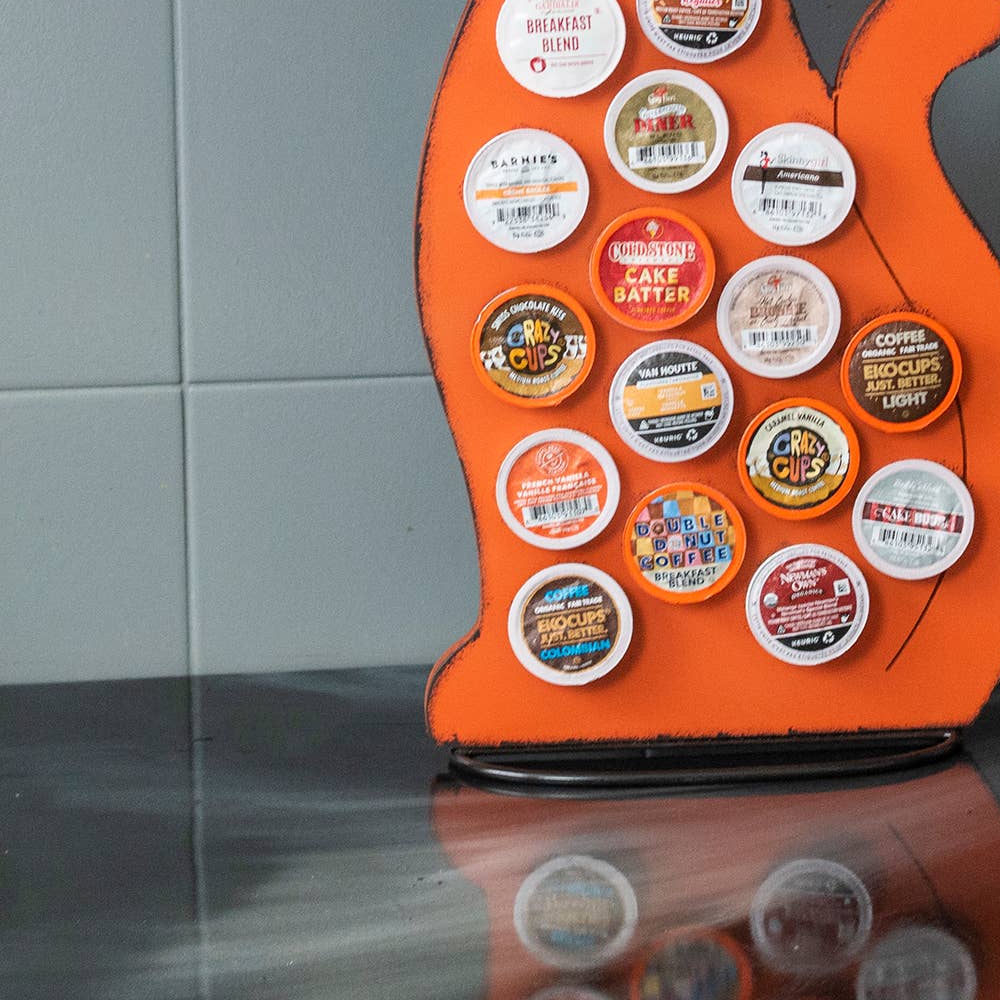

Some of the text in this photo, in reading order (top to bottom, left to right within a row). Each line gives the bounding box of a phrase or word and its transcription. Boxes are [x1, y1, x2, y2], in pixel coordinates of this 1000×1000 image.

[526, 15, 593, 34] BREAKFAST
[542, 36, 580, 53] BLEND
[673, 32, 702, 41] KEURIG
[633, 114, 696, 133] DINER
[491, 154, 558, 168] BARNIE'S
[777, 170, 820, 182] Americano
[608, 241, 696, 263] COLD STONE
[625, 268, 679, 284] CAKE
[613, 286, 690, 303] BATTER
[510, 300, 551, 314] CHOCOLATE
[551, 305, 567, 321] KISS
[507, 319, 560, 347] CRAZY
[875, 329, 926, 348] COFFEE
[509, 344, 561, 371] CUPS
[862, 342, 939, 358] ORGANIC FAIR TRADE
[638, 361, 698, 379] VAN HOUTTE
[863, 357, 941, 380] EKOCUPS
[865, 373, 942, 392] JUST. BETTER.
[882, 391, 929, 409] LIGHT
[798, 412, 825, 428] VANILLA
[654, 433, 683, 444] KEURIG
[773, 429, 825, 457] CRAZY
[772, 455, 825, 482] CUPS
[521, 471, 590, 489] FRENCH VANILLA
[881, 506, 910, 520] CAKE
[637, 514, 723, 537] DOUBLE
[654, 530, 726, 552] DONUT
[641, 547, 728, 569] COFFEE
[654, 566, 717, 581] BREAKFAST
[668, 577, 705, 588] BLEND
[543, 584, 590, 603] COFFEE
[534, 602, 566, 615] ORGANIC
[537, 608, 606, 633] EKOCUPS
[540, 638, 611, 660] COLOMBIAN
[791, 636, 820, 648] KEURIG
